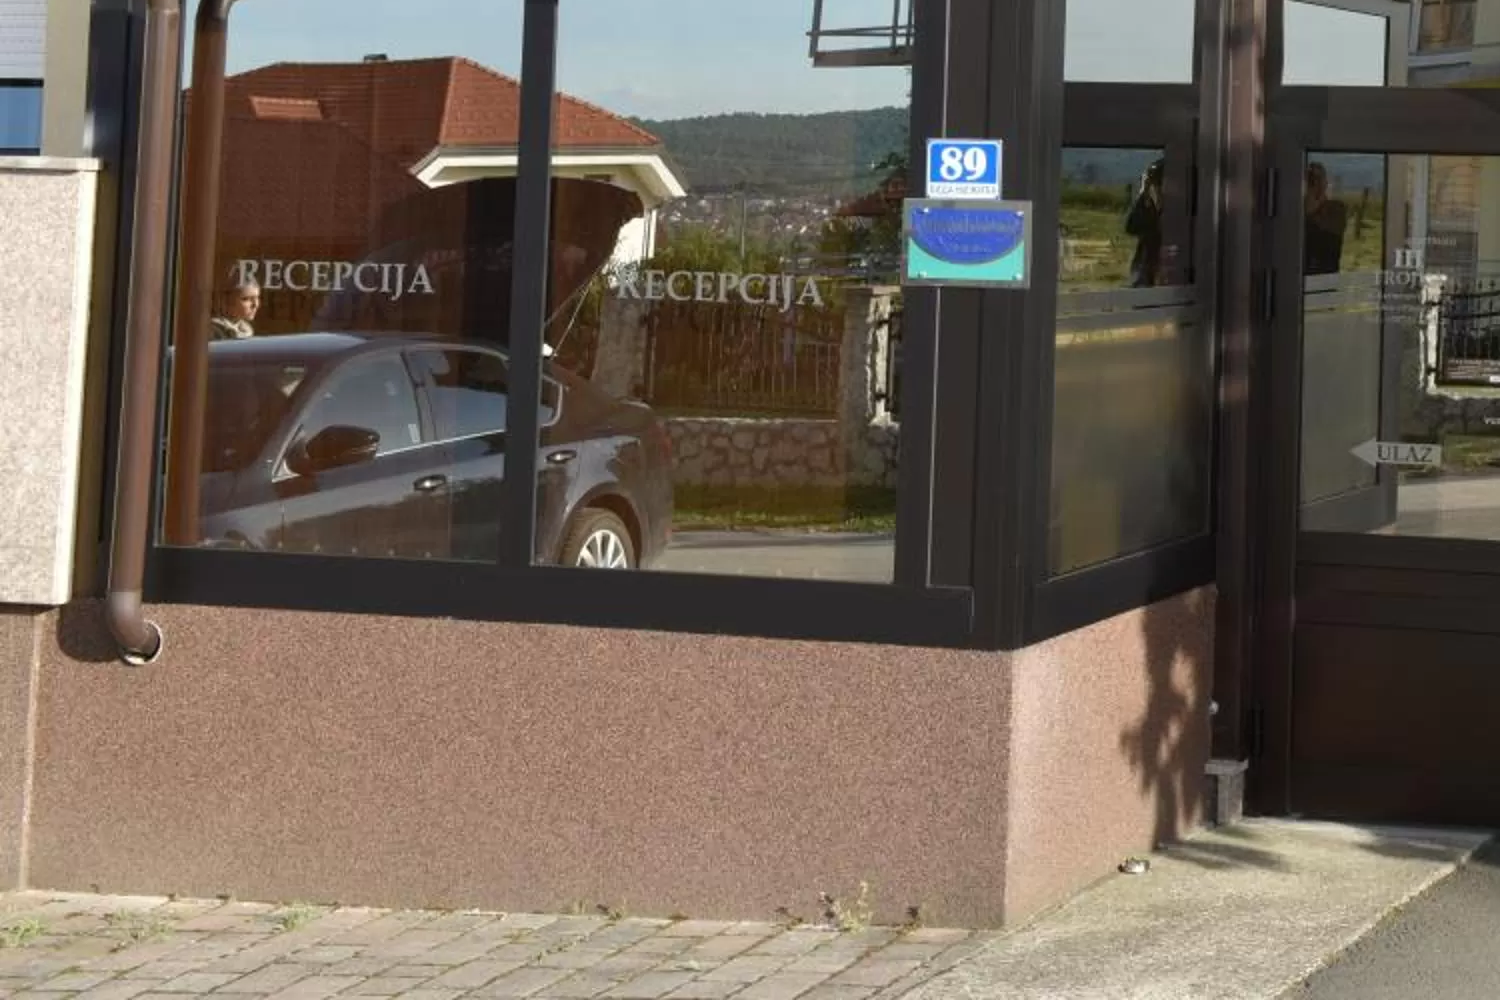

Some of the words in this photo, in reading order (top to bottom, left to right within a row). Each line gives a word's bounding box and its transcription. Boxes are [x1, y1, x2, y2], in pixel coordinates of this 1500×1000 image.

[939, 147, 987, 181] 89
[235, 259, 434, 300] RECEPCIJA
[617, 269, 823, 313] RECEPCIJA
[1377, 446, 1432, 461] ULAZ
